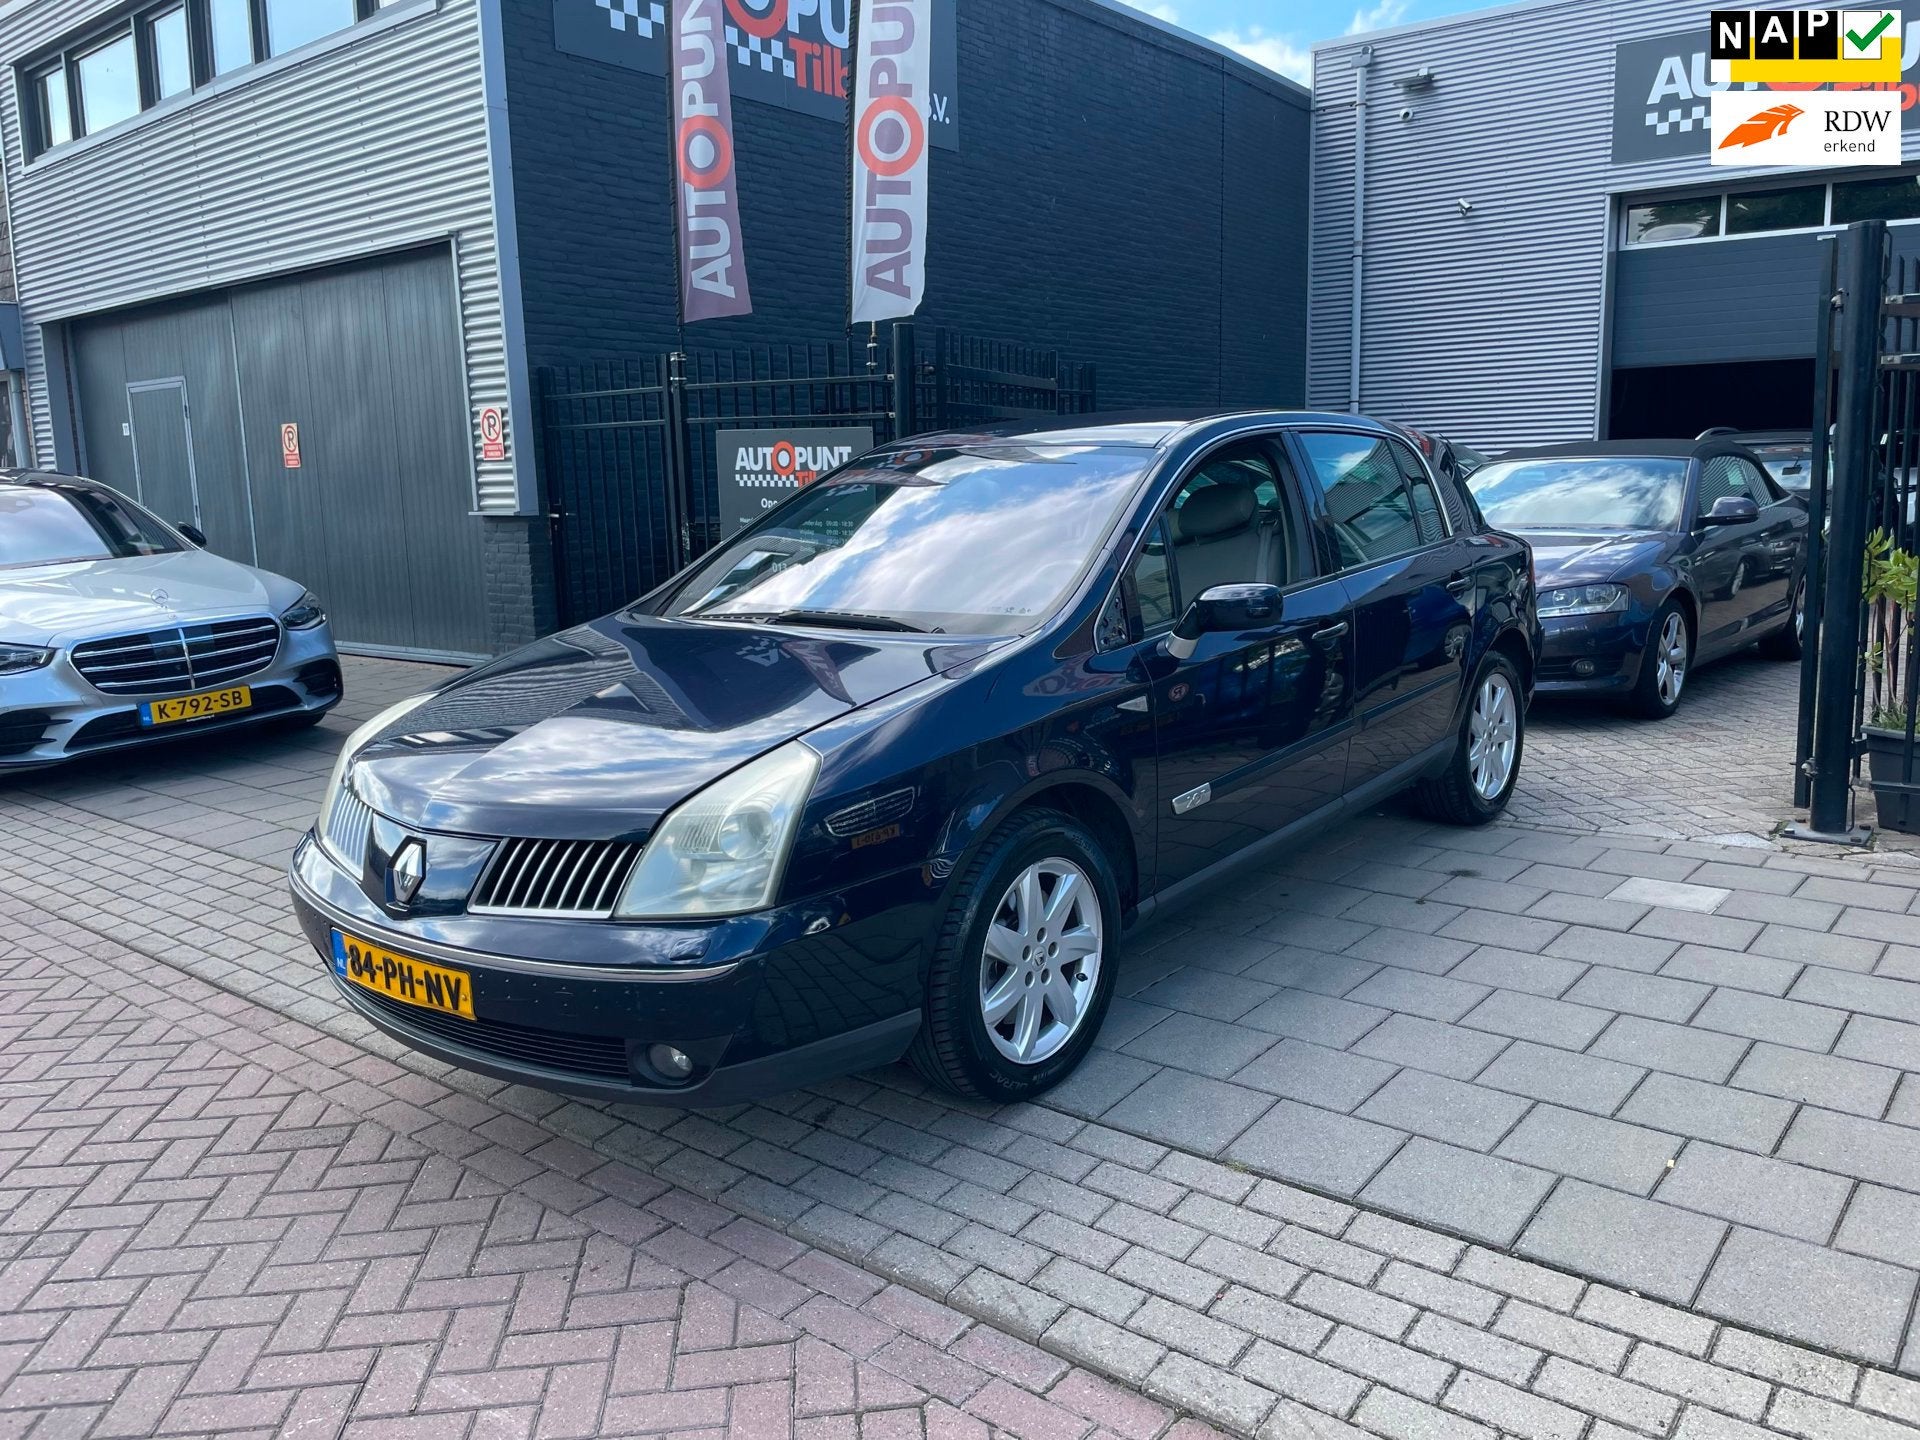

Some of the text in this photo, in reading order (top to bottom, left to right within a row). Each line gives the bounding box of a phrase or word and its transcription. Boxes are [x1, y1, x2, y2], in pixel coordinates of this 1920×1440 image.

[857, 0, 924, 300] AUTOPU
[735, 441, 852, 476] AUTOPUNT
[760, 498, 778, 509] Op
[157, 690, 243, 720] K-792-SB
[348, 944, 461, 1011] 84-PH-NV
